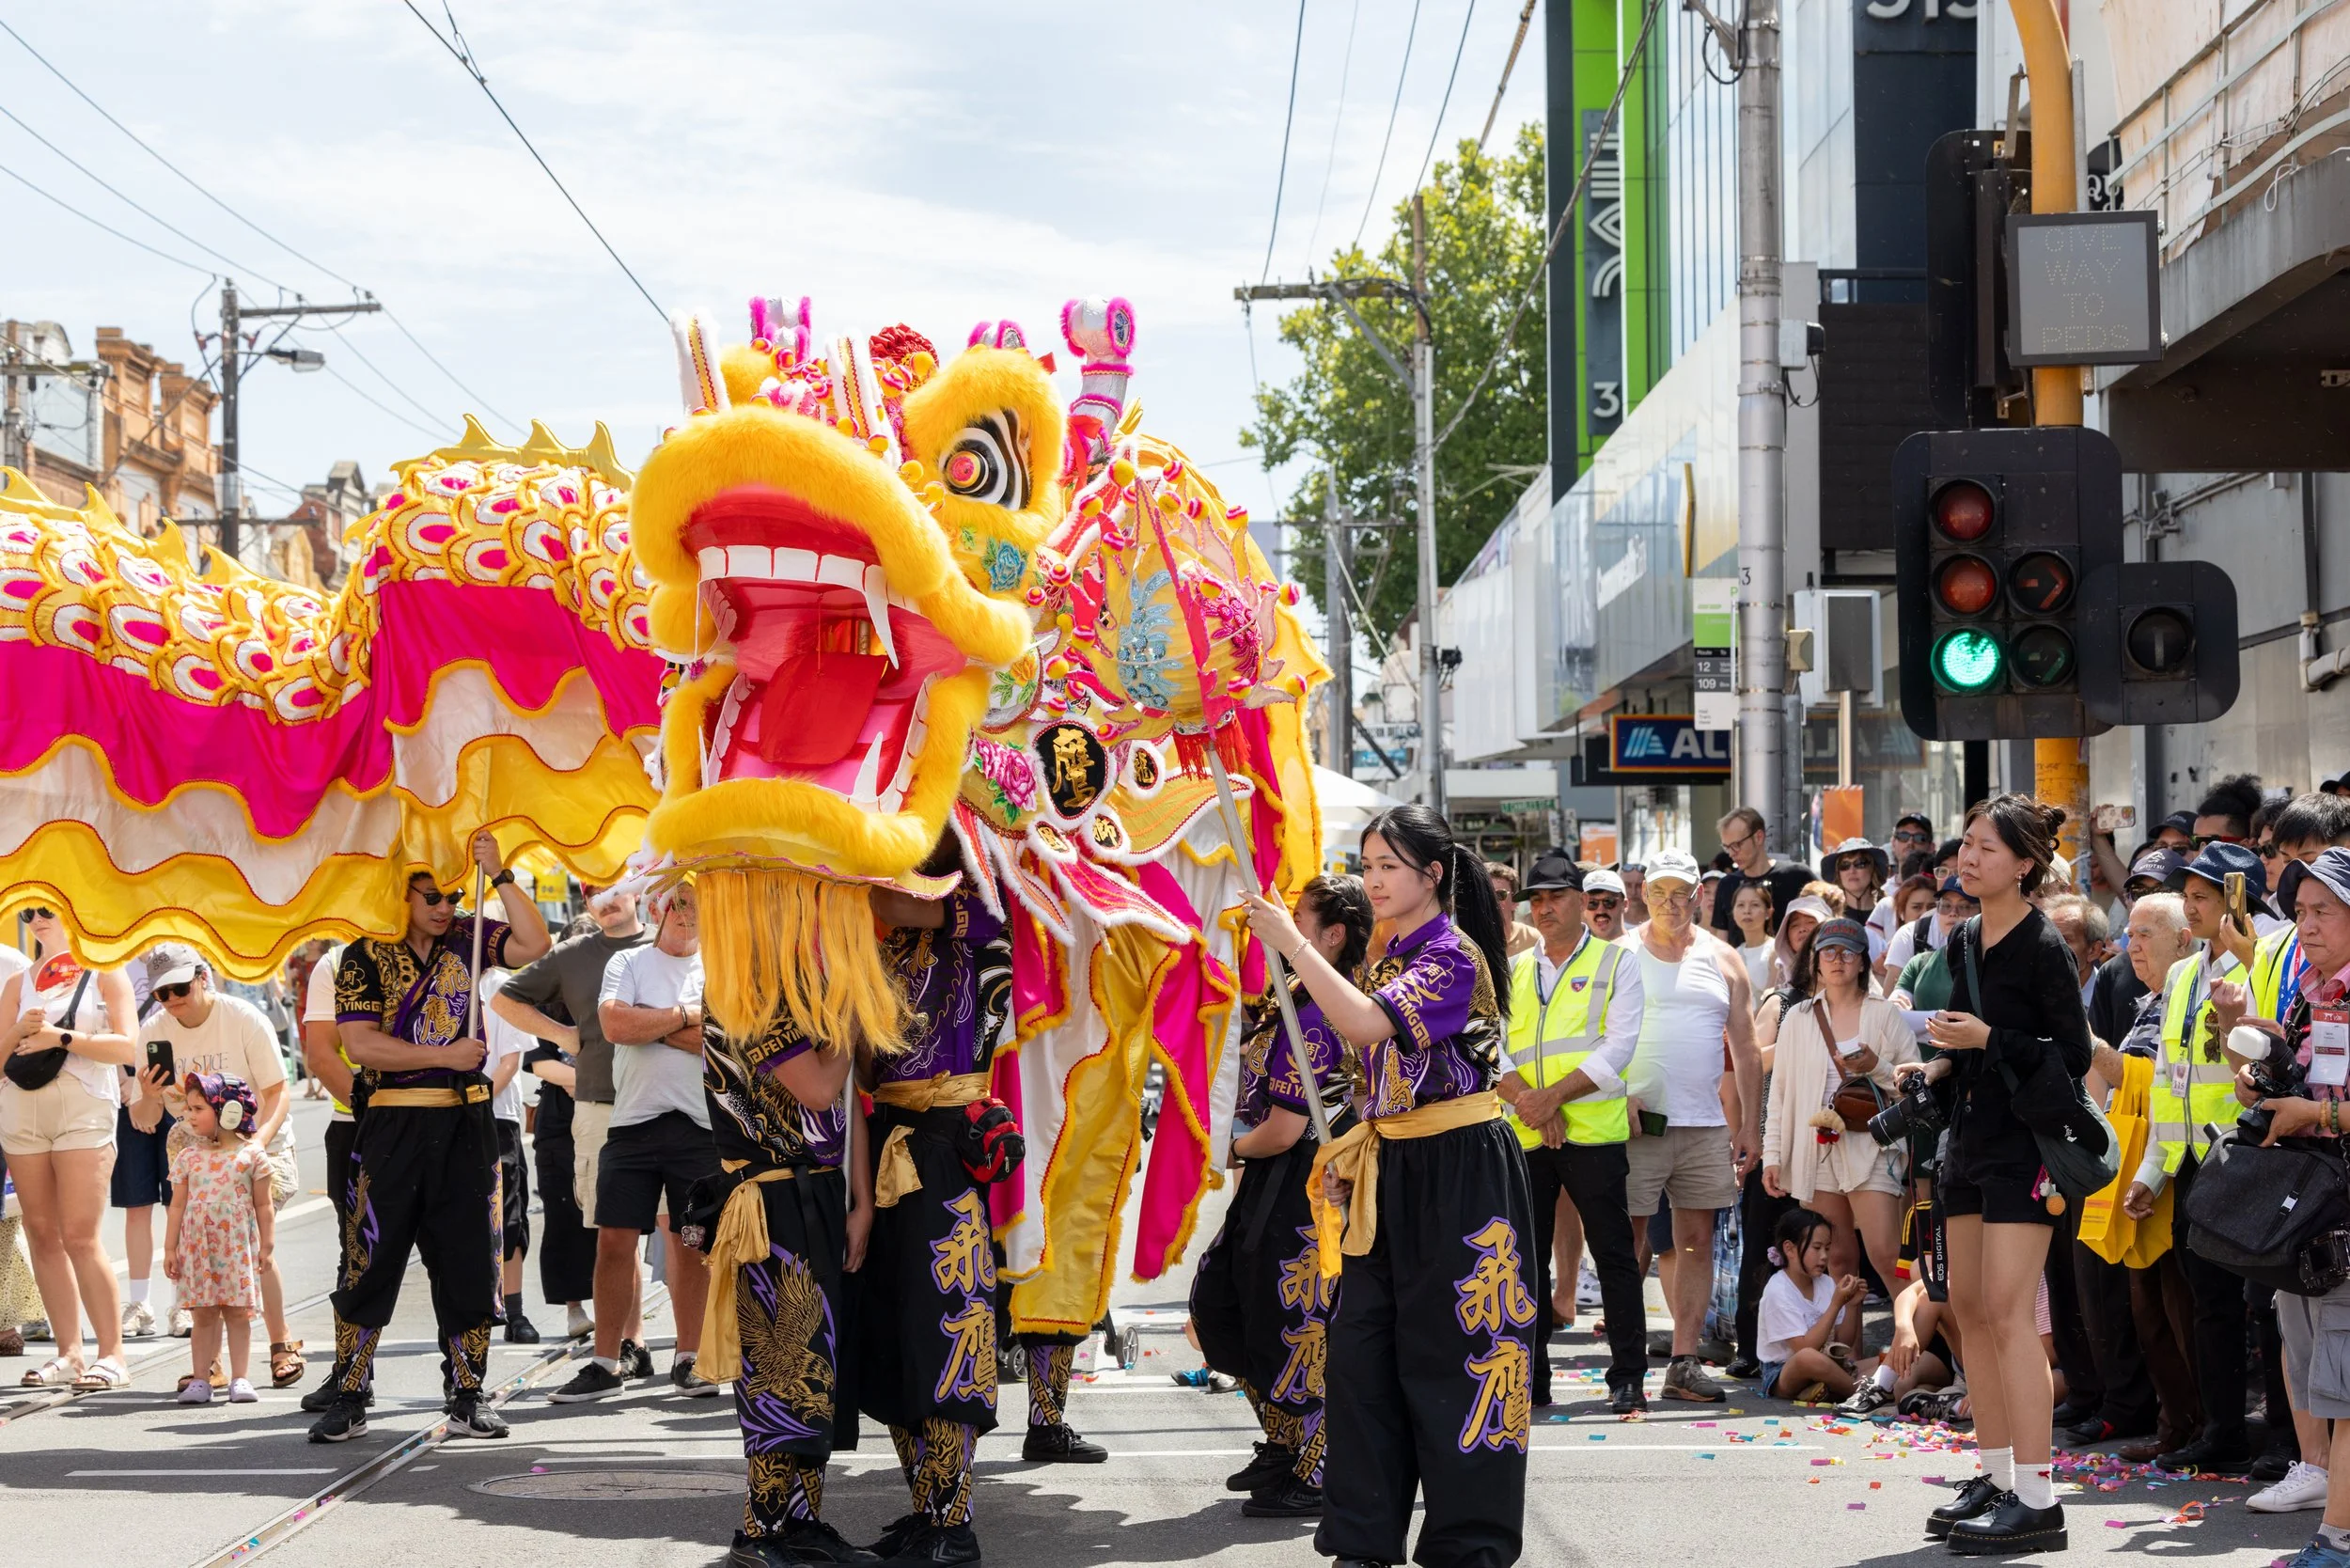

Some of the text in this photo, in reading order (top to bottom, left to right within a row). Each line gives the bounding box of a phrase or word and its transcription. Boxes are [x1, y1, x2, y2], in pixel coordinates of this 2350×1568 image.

[2044, 225, 2122, 252] GIVE
[2044, 258, 2122, 285] WAY
[2062, 291, 2105, 318] TO
[2042, 323, 2129, 353] PEDS
[1698, 662, 1711, 672] 12
[1698, 679, 1716, 689] 109
[344, 1000, 370, 1011] YING
[760, 1027, 806, 1057] FEI YIN
[175, 1053, 228, 1074] OLSTICE
